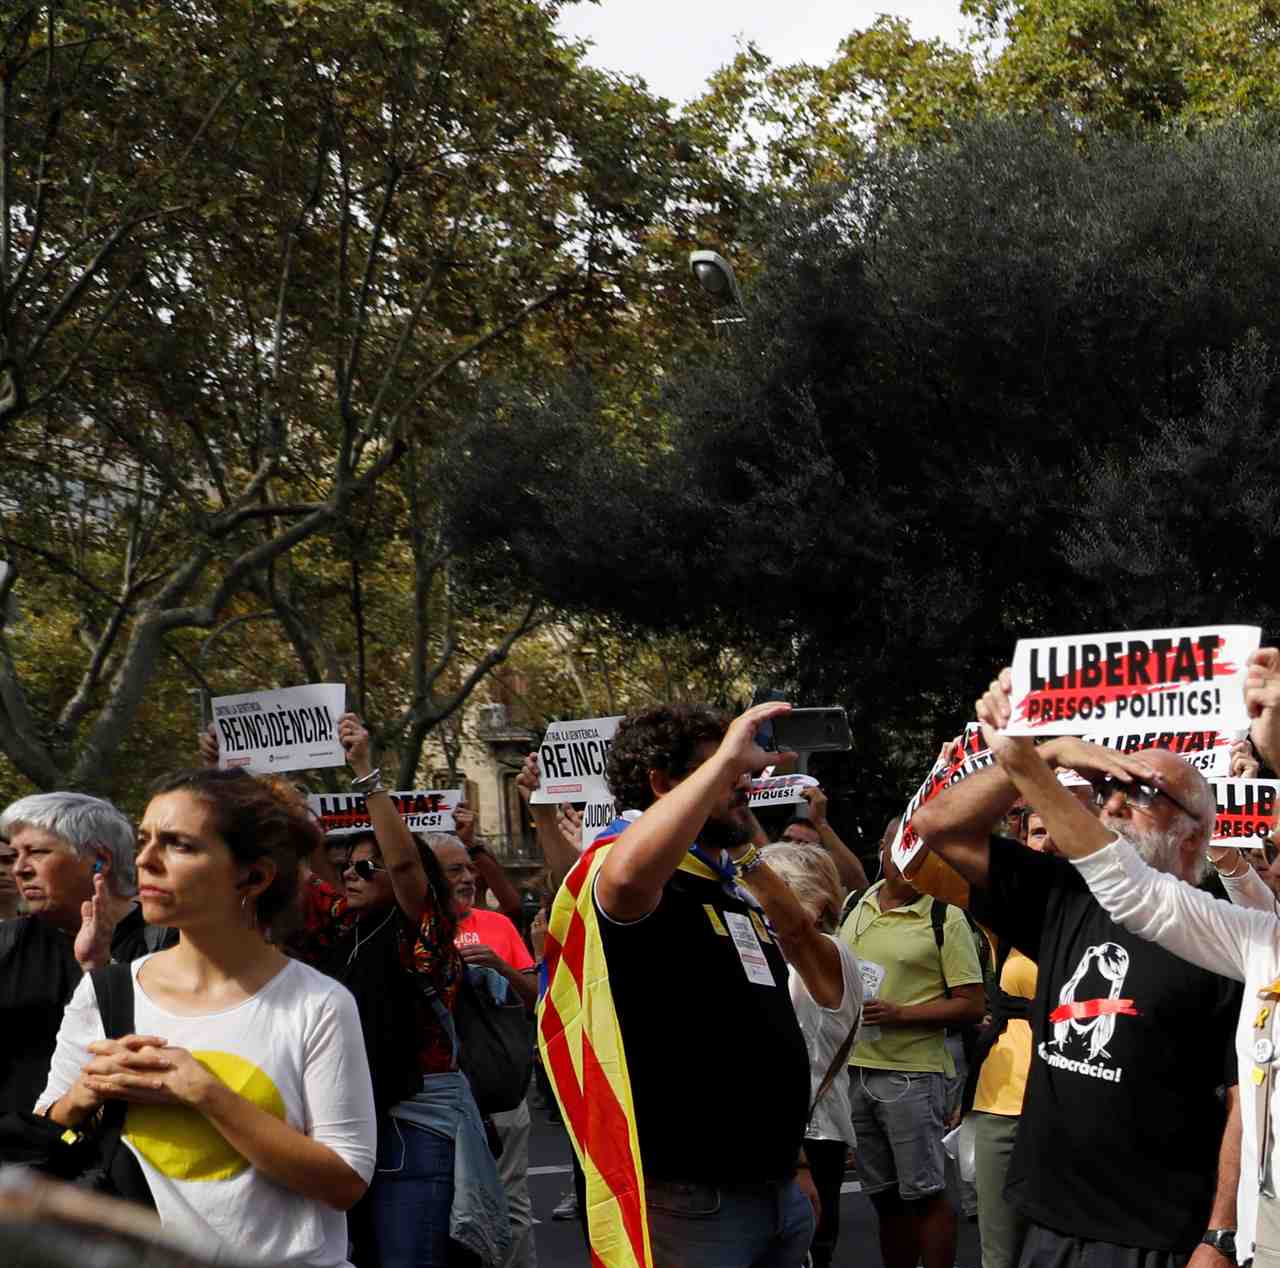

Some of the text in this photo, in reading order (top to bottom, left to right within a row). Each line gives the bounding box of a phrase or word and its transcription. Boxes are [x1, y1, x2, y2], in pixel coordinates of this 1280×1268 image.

[1029, 634, 1221, 691] LLIBERTAT
[1027, 694, 1107, 722] PRESOS
[218, 703, 334, 752] REINCIDÈNCIA!
[541, 740, 611, 779] REINCI
[1212, 783, 1278, 816] LLIB
[1212, 818, 1275, 839] PRESO
